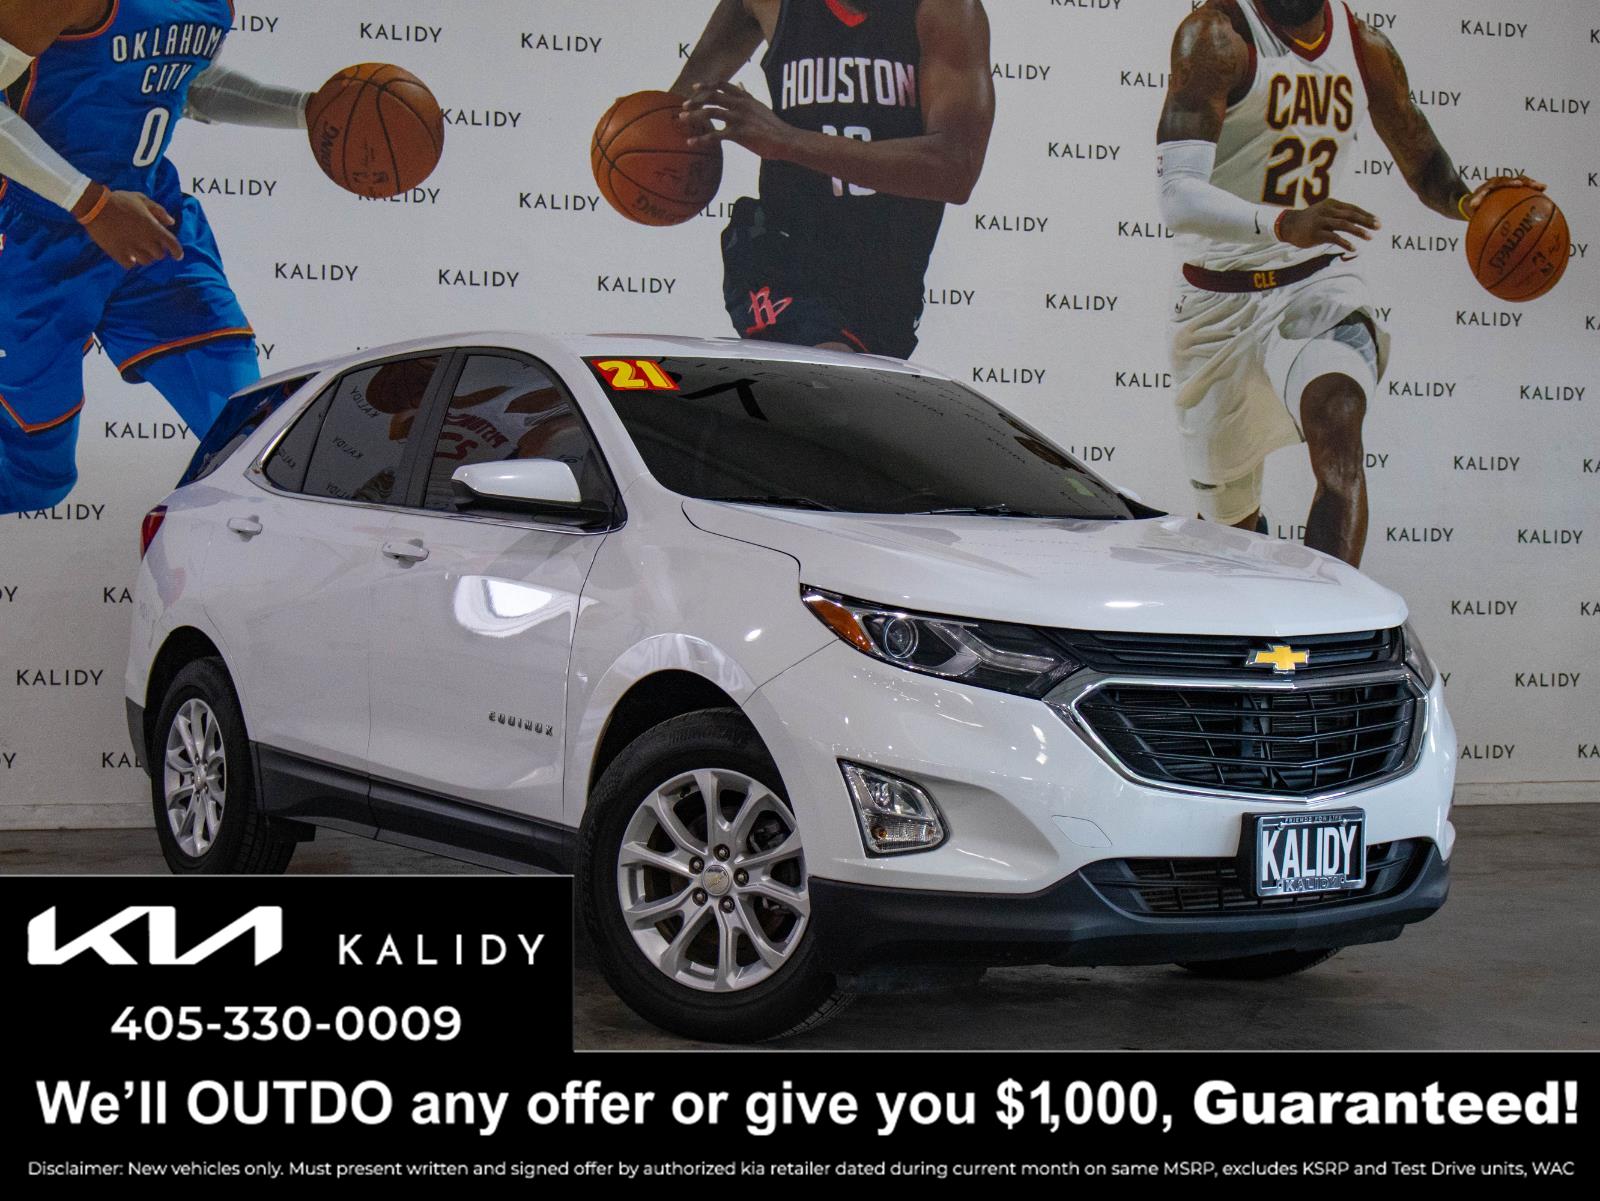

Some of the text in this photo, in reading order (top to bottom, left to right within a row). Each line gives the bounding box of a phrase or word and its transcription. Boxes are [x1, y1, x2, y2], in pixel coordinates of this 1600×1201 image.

[230, 15, 280, 33] IDY
[1354, 12, 1397, 29] IDY
[1461, 20, 1528, 38] KALIDY
[360, 23, 442, 43] KALIDY
[521, 33, 602, 53] KALIDY
[141, 63, 192, 94] CITY
[992, 63, 1051, 80] ALIDY
[1120, 71, 1164, 88] KALI
[782, 57, 916, 110] HOUSTON
[1266, 73, 1353, 132] CAVS
[1408, 90, 1462, 106] ALIDY
[1525, 97, 1591, 114] KALIDY
[441, 108, 522, 127] KALIDY
[132, 107, 170, 167] 0
[1048, 142, 1121, 160] KALIDY
[1262, 136, 1338, 207] 23
[1355, 160, 1394, 175] IDY
[192, 177, 277, 196] KALIDY
[519, 192, 600, 211] KALIDY
[976, 214, 1048, 232] KALIDY
[1391, 235, 1459, 252] KALIDY
[275, 263, 358, 281] KALIDY
[439, 269, 520, 287] KALIDY
[1253, 271, 1278, 289] CLE
[598, 276, 676, 294] KALIDY
[929, 288, 975, 305] LIDY
[1046, 293, 1118, 311] KALIDY
[1456, 310, 1523, 328] KALIDY
[597, 360, 675, 389] 21
[973, 367, 1046, 384] KALIDY
[1116, 371, 1172, 388] KALID
[1389, 380, 1457, 397] KALIDY
[1520, 384, 1586, 402] KALIDY
[105, 422, 190, 439] KALIDY
[1072, 446, 1116, 461] IDY
[1453, 455, 1521, 471] KALIDY
[1278, 525, 1307, 540] LID
[1386, 527, 1454, 543] KALIDY
[1517, 529, 1584, 545] KALIDY
[1451, 600, 1518, 616] KALIDY
[16, 670, 104, 686] KALIDY
[1515, 673, 1581, 687] KALIDY
[488, 711, 553, 737] EQUINOX
[102, 752, 142, 768] KAL
[1460, 744, 1516, 760] ALIDY
[1262, 825, 1358, 882] KALIDY
